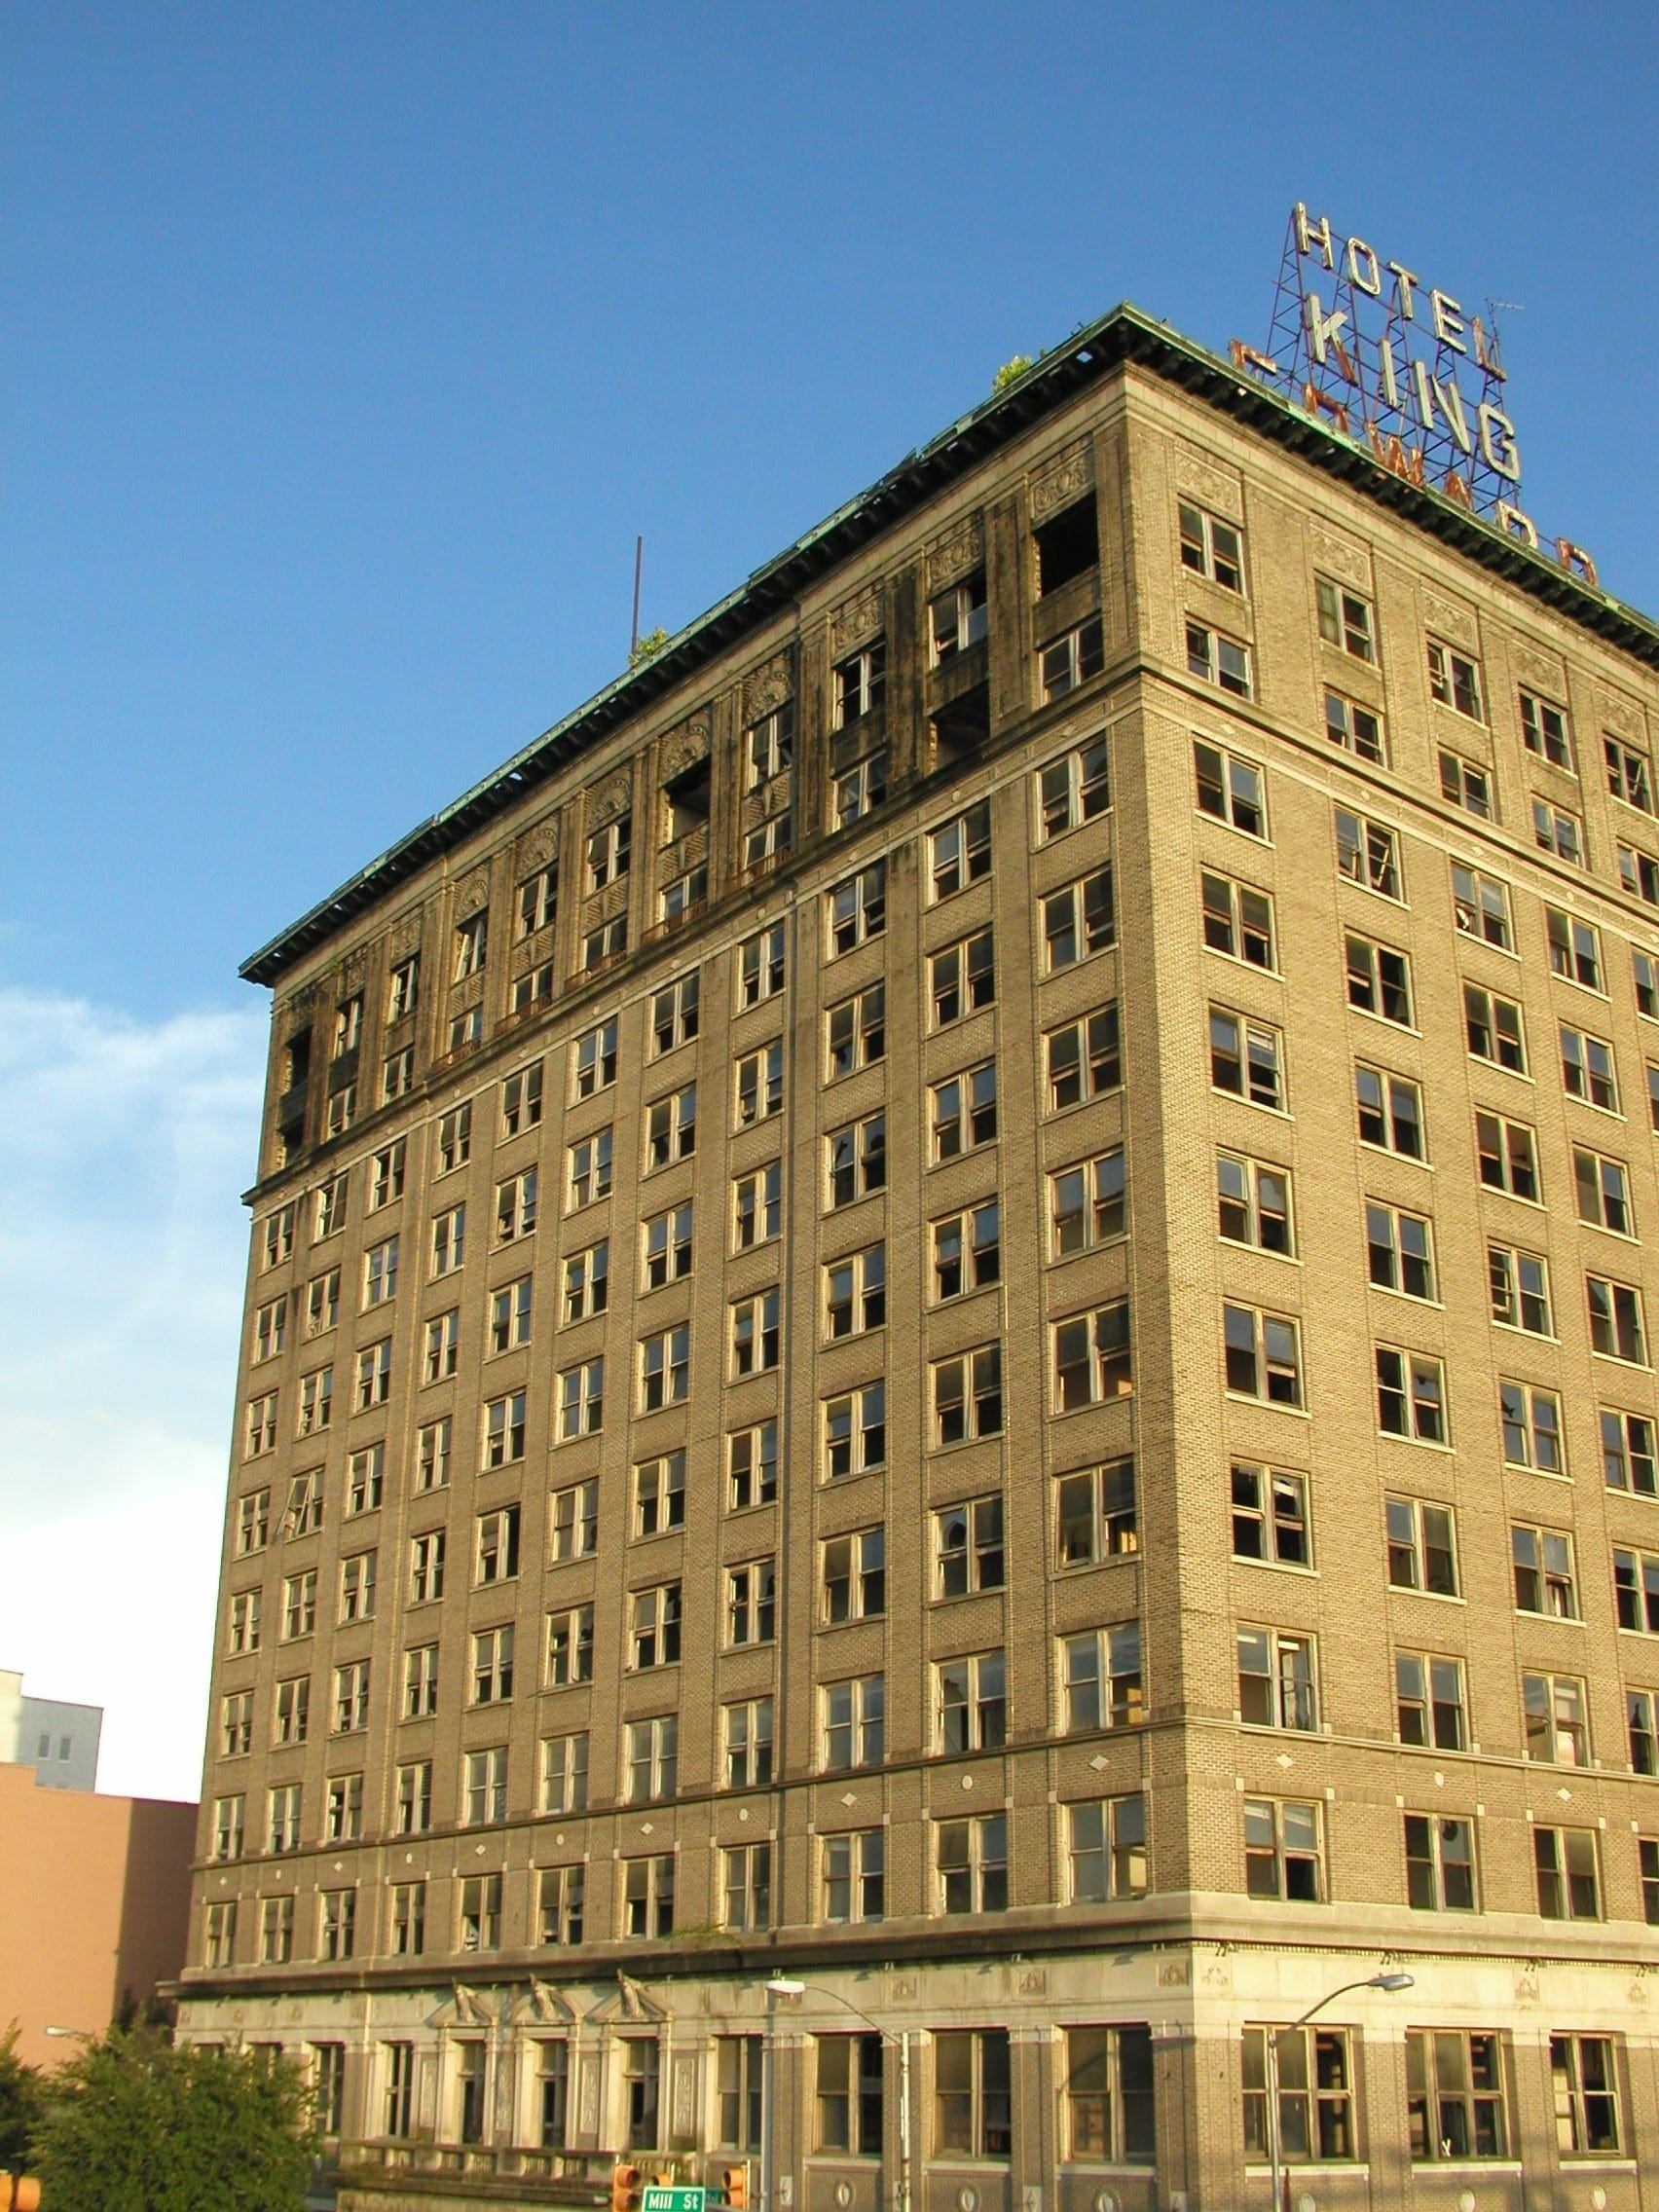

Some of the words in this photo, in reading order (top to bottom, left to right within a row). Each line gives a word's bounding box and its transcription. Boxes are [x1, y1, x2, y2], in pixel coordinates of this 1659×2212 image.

[1293, 201, 1507, 382] HOTEL
[1306, 292, 1521, 482] KING
[648, 2193, 674, 2209] Mill
[683, 2193, 699, 2210] St
